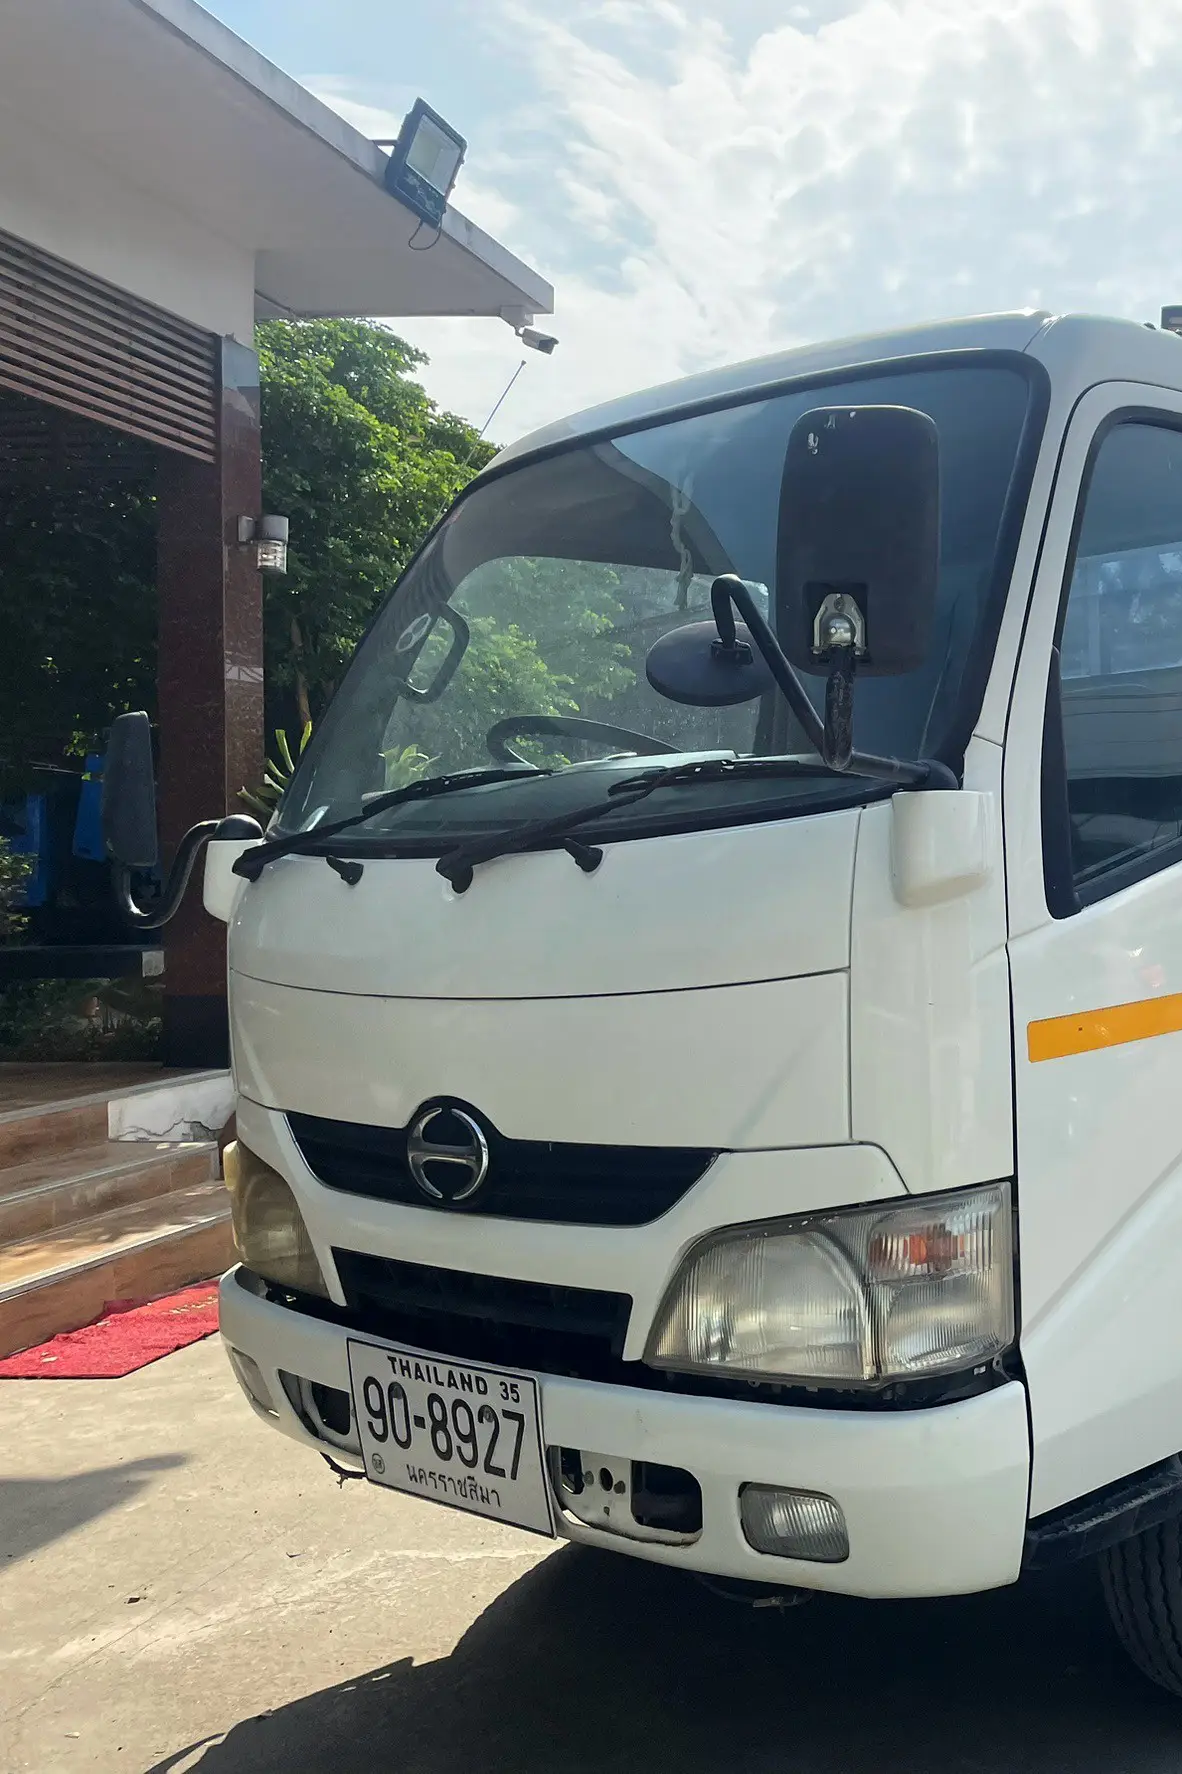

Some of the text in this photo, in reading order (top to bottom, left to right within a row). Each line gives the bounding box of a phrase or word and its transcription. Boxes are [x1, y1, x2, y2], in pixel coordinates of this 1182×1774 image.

[387, 1355, 521, 1404] THAILAND 35
[362, 1375, 525, 1481] 90-8927
[406, 1464, 501, 1508] นครราชสีมา
